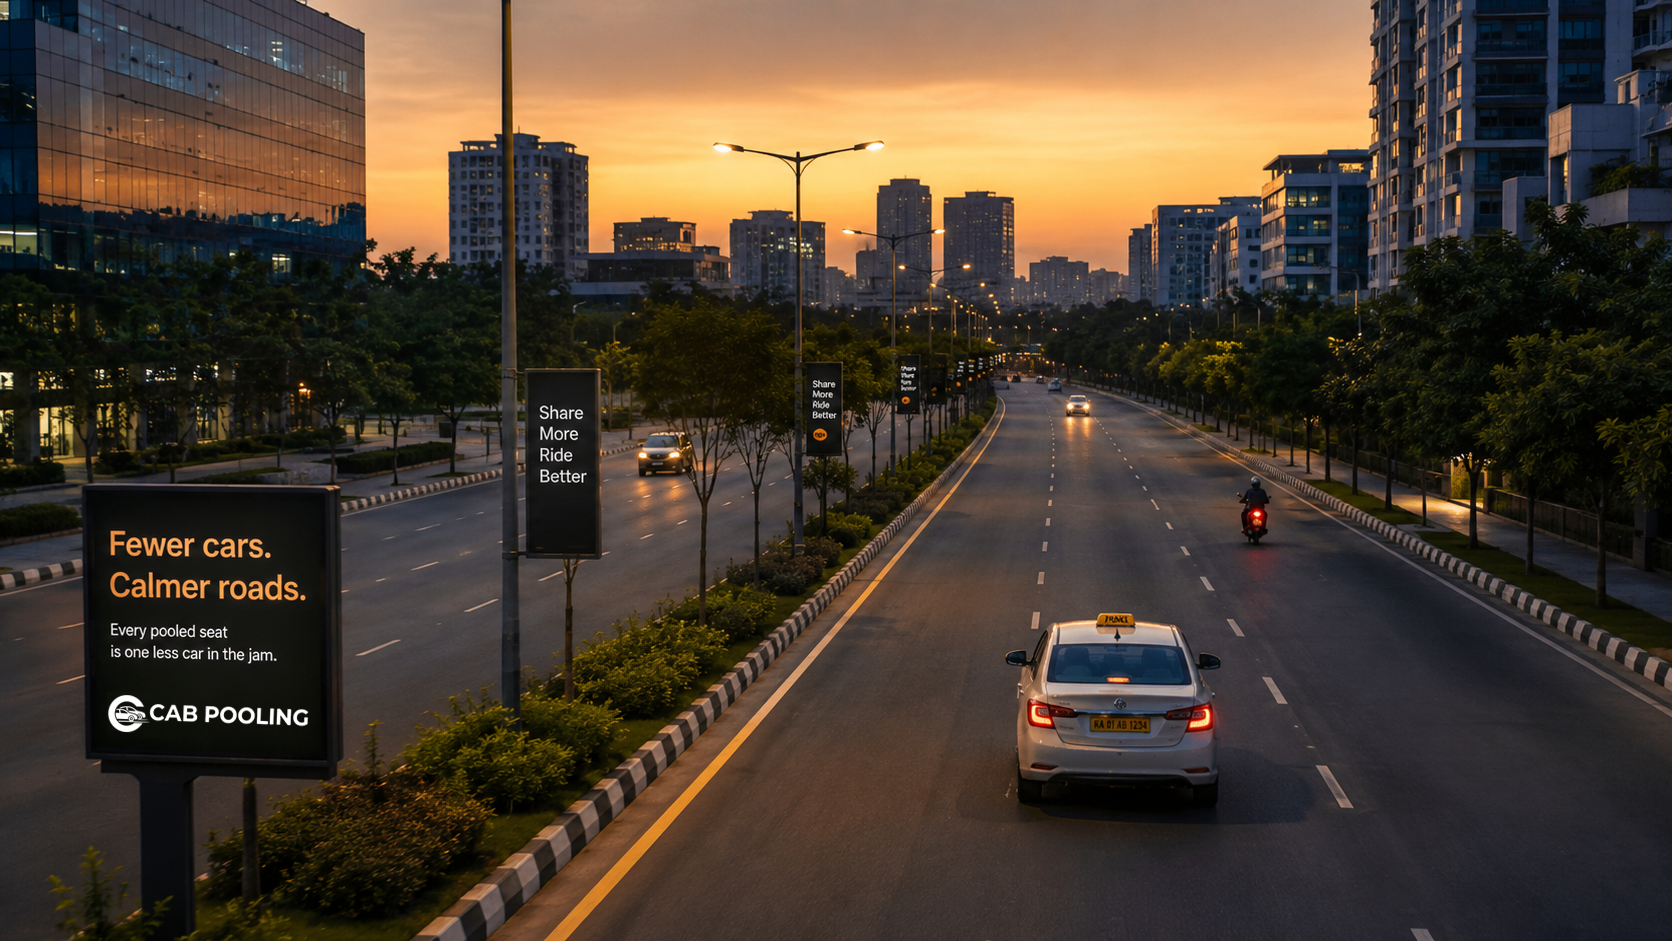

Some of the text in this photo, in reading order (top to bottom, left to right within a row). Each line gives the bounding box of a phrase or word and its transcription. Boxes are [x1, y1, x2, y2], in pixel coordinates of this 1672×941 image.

[812, 379, 836, 389] Share
[812, 390, 834, 399] More
[539, 405, 584, 420] Share
[539, 426, 579, 441] More
[539, 447, 573, 462] Ride
[539, 469, 587, 484] Better
[110, 530, 271, 559] Fewer cars.
[110, 571, 307, 601] Calmer roads.
[110, 623, 228, 640] Every pooled seat
[110, 645, 278, 664] is one less car in the jam.
[149, 703, 309, 727] CAB POOLING
